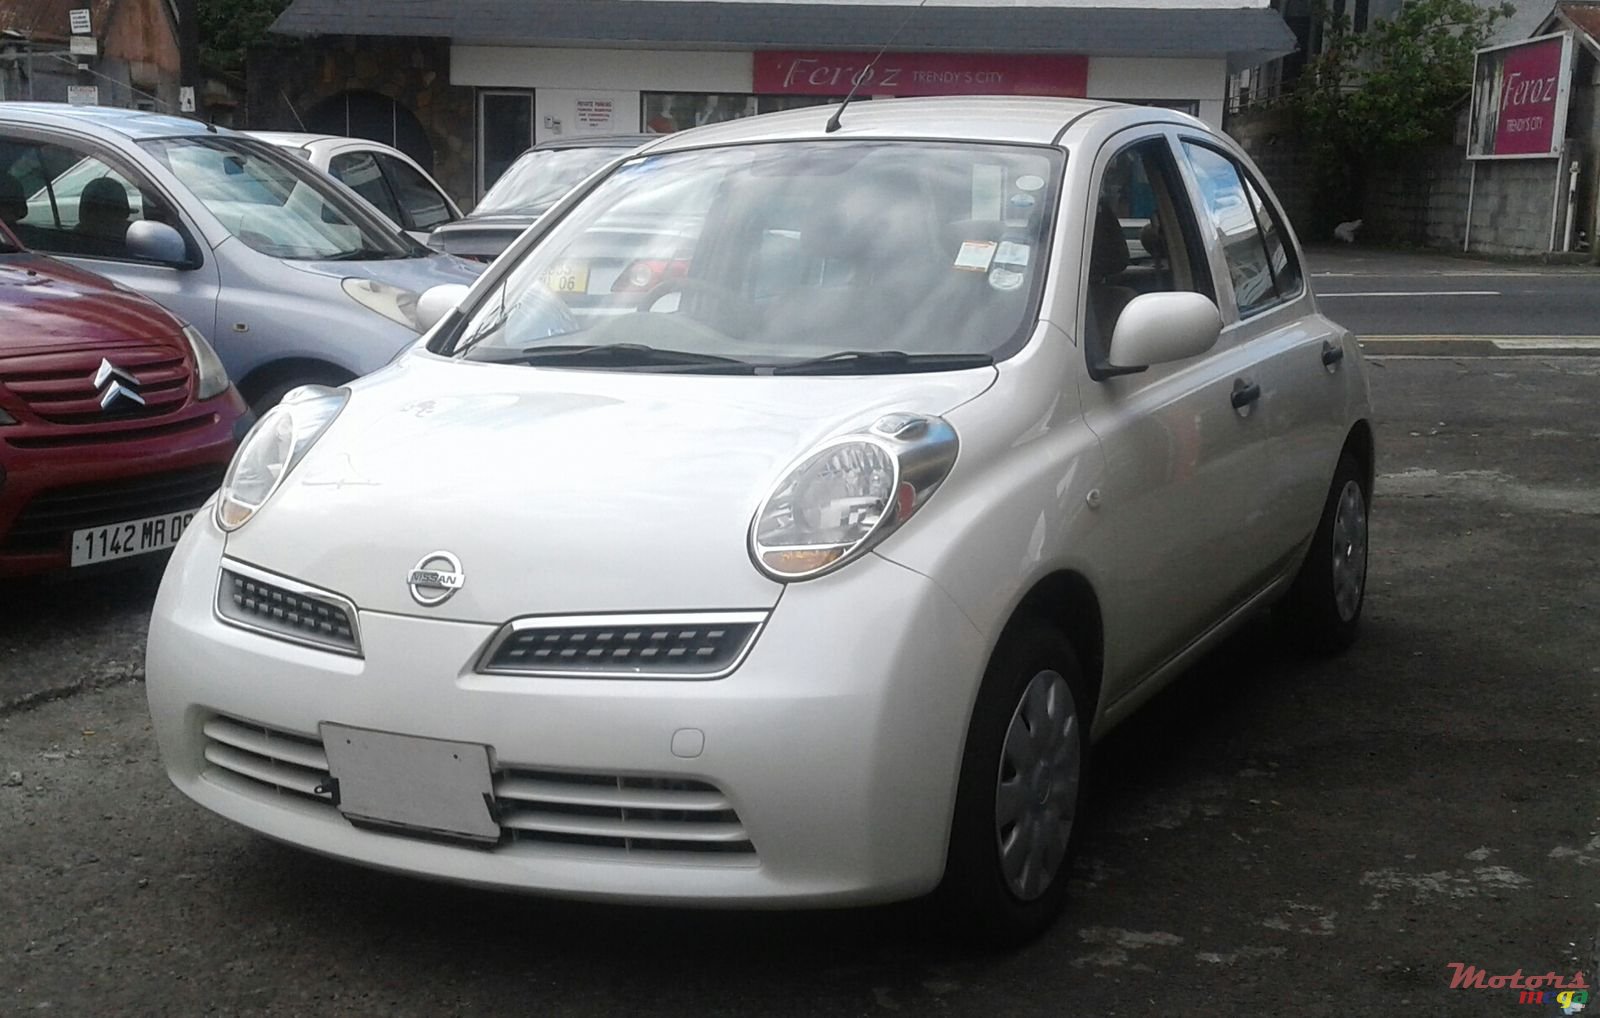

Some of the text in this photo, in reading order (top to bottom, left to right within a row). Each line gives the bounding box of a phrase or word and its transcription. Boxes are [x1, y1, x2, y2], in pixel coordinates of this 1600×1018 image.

[779, 58, 902, 88] Feroz
[975, 70, 1004, 84] CITY
[1502, 72, 1556, 110] Feroz
[559, 276, 576, 290] 06
[85, 524, 136, 560] 1142
[140, 518, 166, 549] MR
[411, 571, 457, 585] NISSAN
